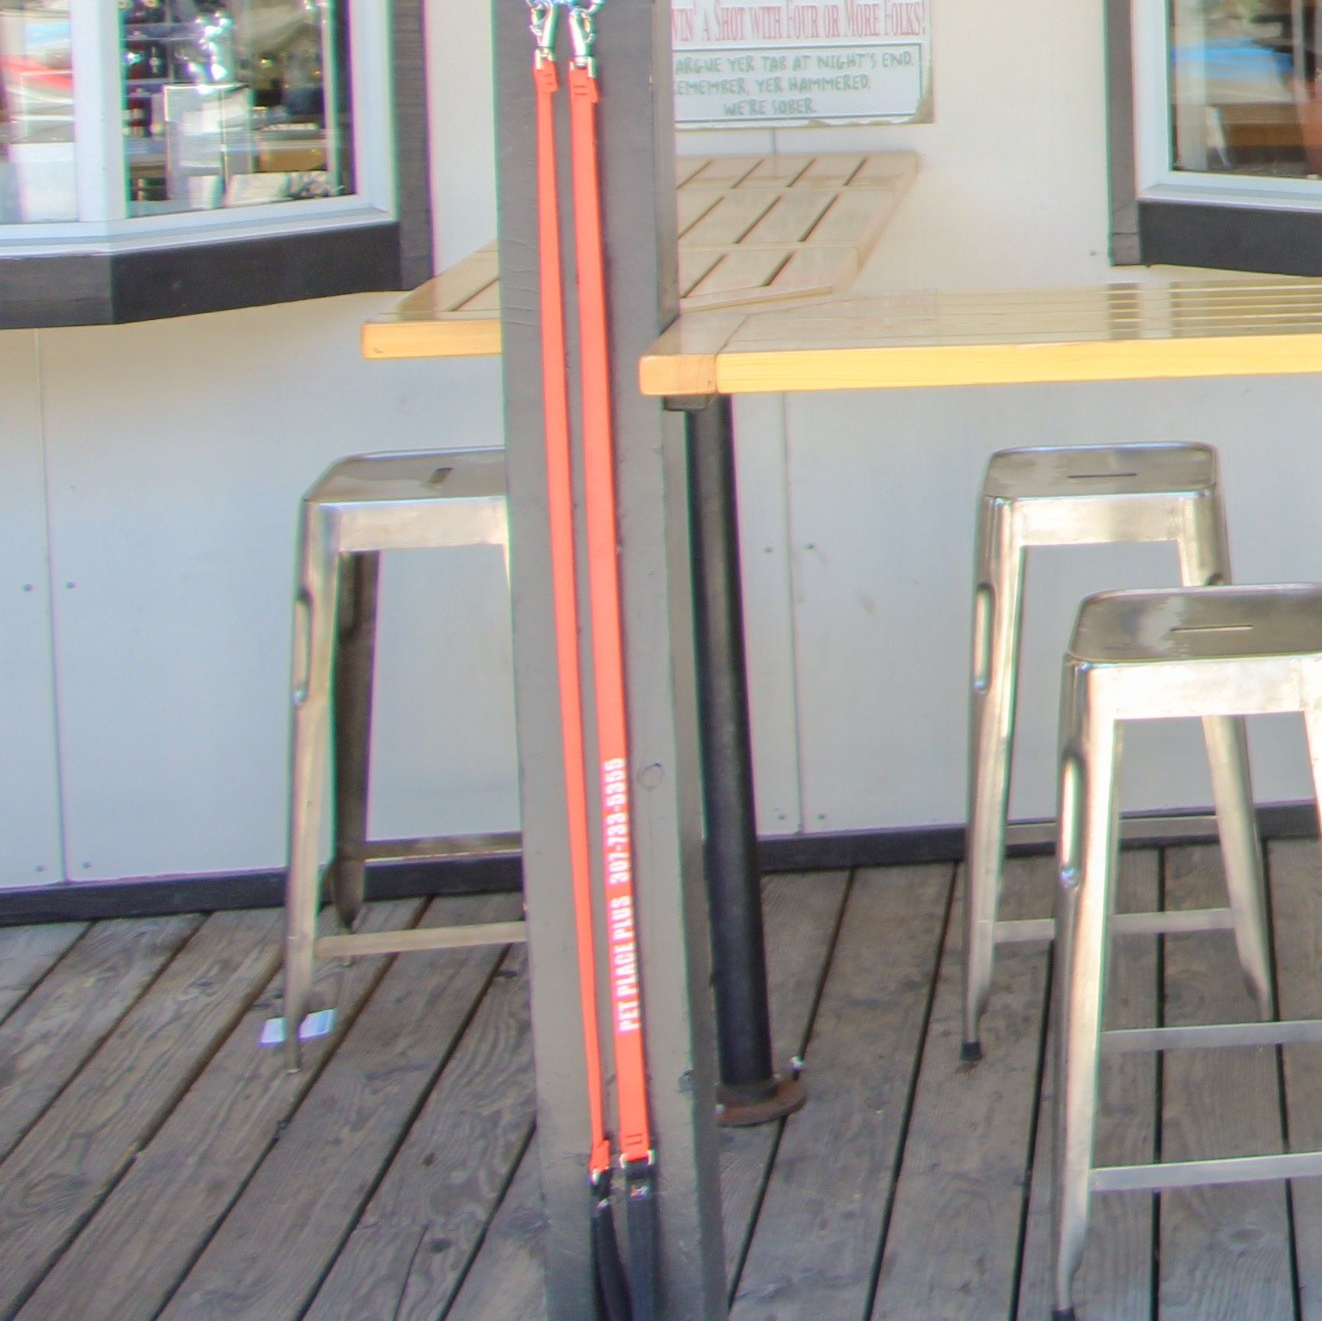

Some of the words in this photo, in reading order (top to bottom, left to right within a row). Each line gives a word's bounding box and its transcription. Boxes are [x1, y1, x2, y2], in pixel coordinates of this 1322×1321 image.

[674, 56, 723, 75] ARGUE
[727, 54, 756, 73] YER
[760, 54, 787, 73] TAB
[792, 54, 811, 72] AT
[815, 52, 877, 69] NIGHT'S
[881, 50, 914, 68] END.
[755, 76, 783, 94] YER
[788, 73, 871, 94] HAMMERED.
[771, 96, 817, 116] SOBER.
[610, 895, 634, 941] PLUS
[613, 941, 638, 998] PLACE
[617, 1000, 642, 1033] PET
